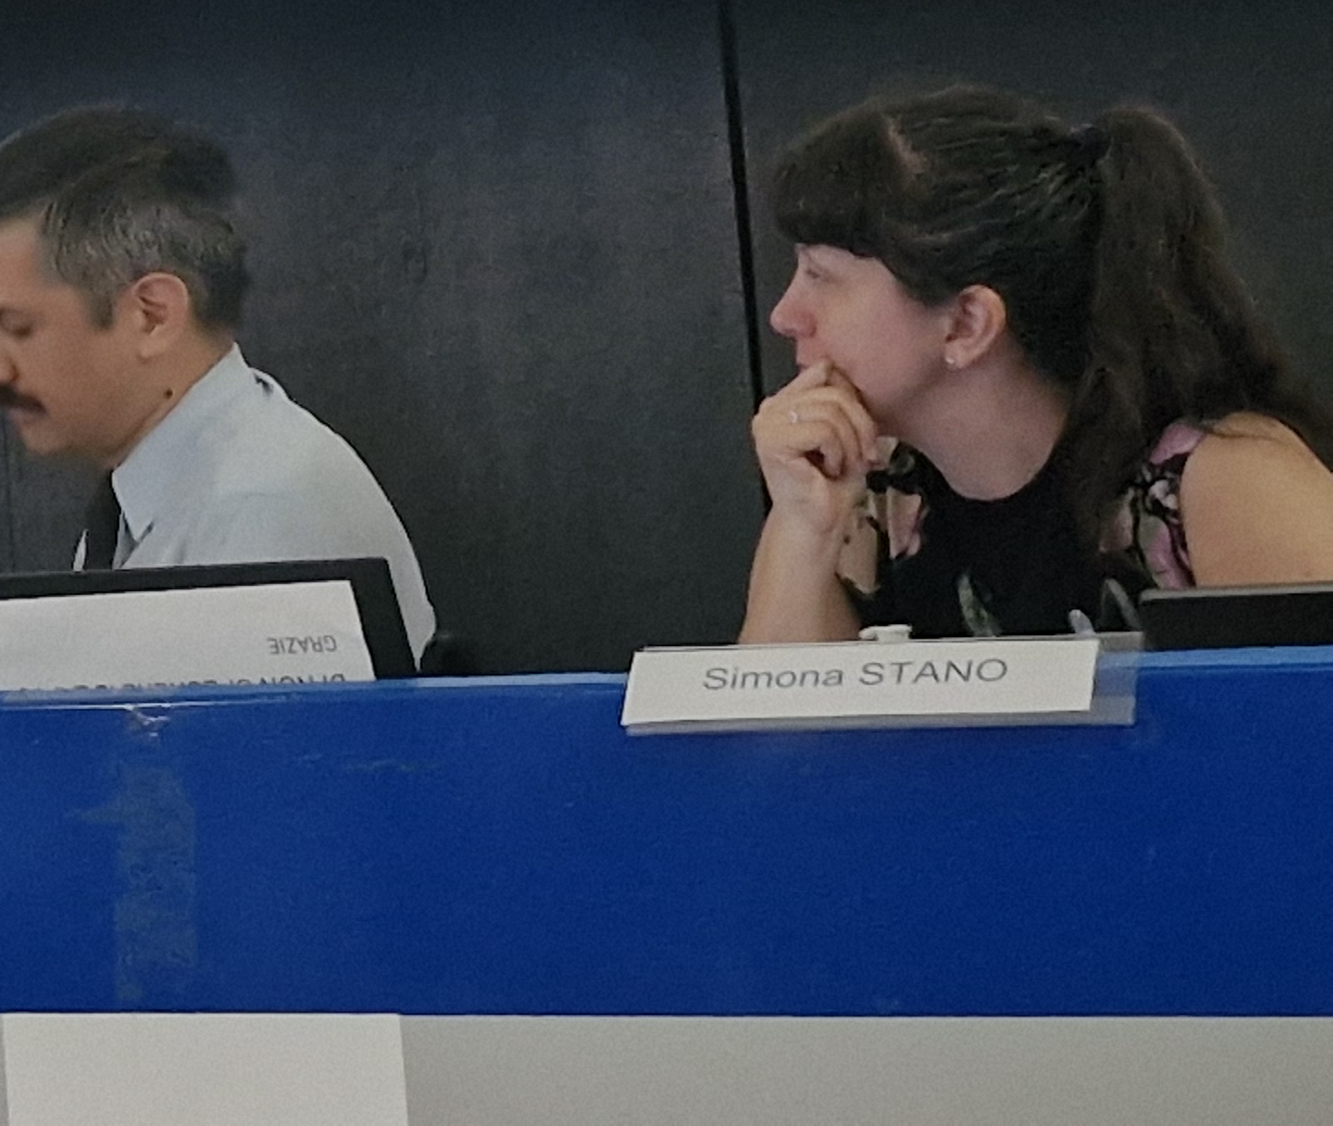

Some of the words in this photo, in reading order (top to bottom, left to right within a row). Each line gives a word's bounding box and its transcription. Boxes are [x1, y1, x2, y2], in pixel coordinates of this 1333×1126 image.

[268, 634, 338, 656] GRAZIE
[703, 666, 844, 691] Simona
[858, 658, 1008, 686] STANO
